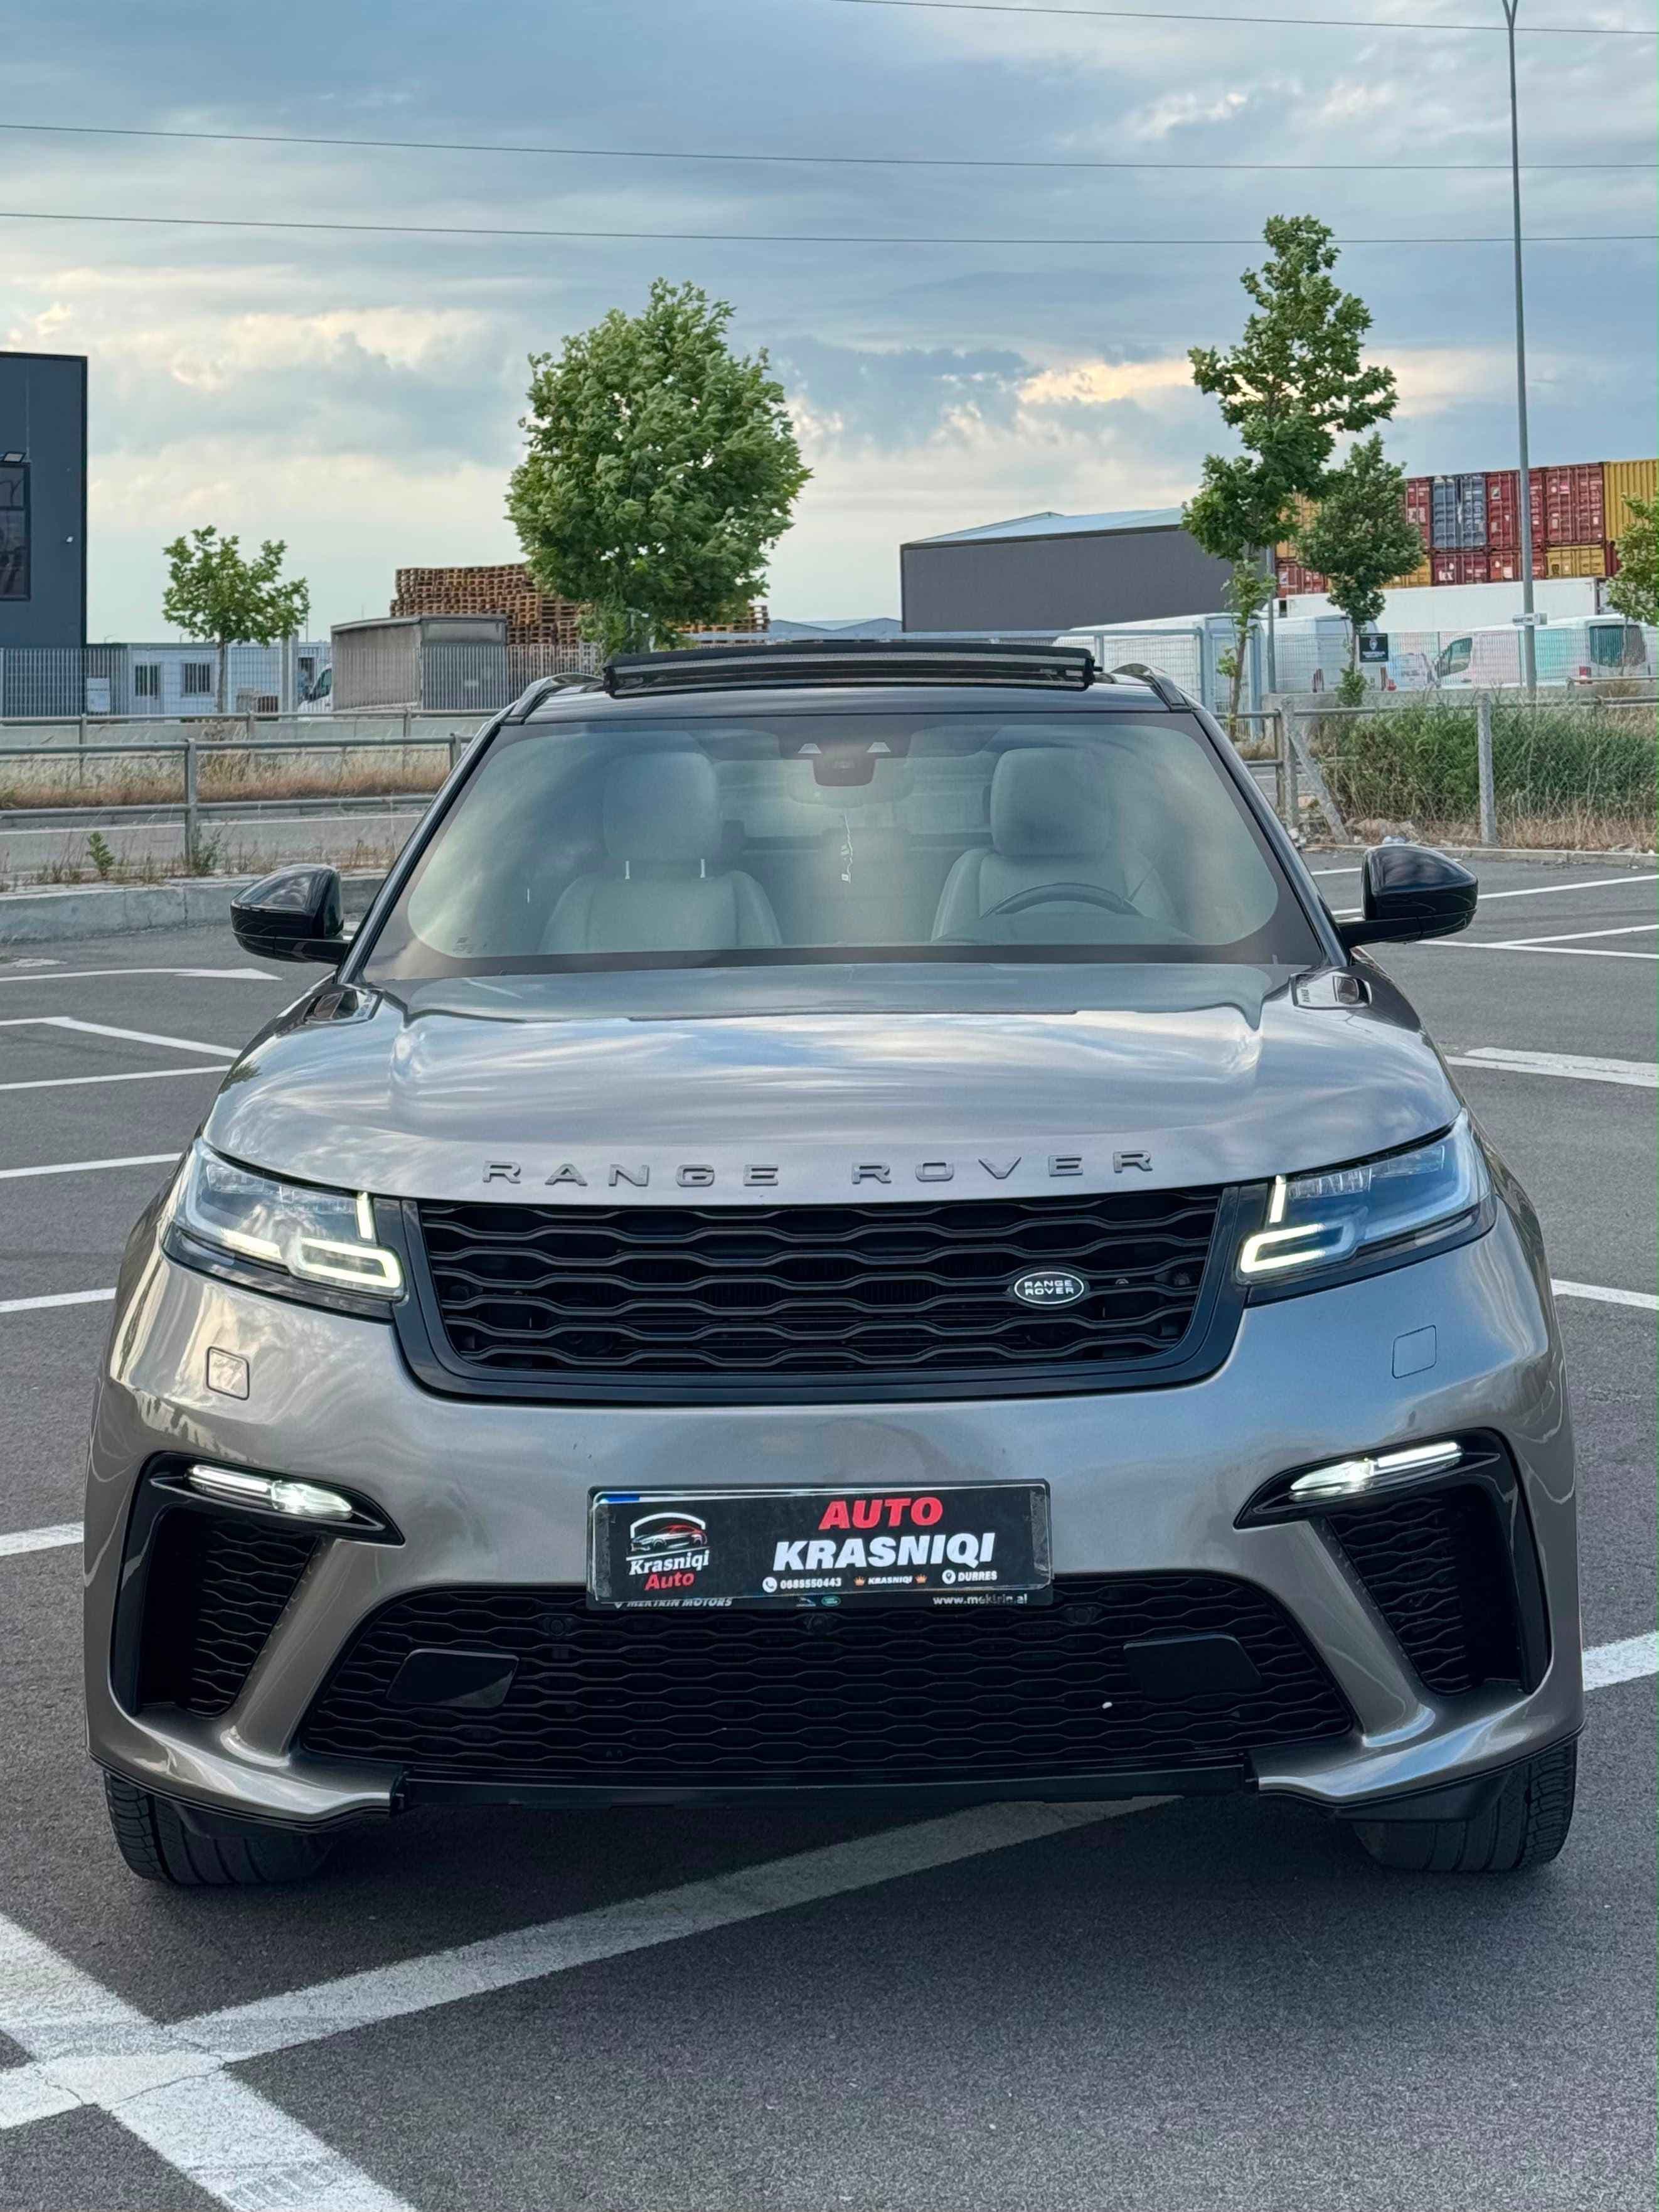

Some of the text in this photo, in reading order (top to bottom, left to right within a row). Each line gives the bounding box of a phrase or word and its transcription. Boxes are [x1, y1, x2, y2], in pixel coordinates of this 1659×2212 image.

[483, 1150, 1154, 1187] RANGE ROVER
[1024, 1280, 1072, 1288] RANGE
[1025, 1287, 1074, 1296] ROVER
[818, 1496, 943, 1531] AUTO
[772, 1532, 995, 1571] KRASNIQI
[628, 1549, 710, 1576] Krasniqi
[643, 1571, 695, 1591] Auto
[868, 1575, 913, 1585] KRASNIQI
[958, 1570, 998, 1582] DURRES
[681, 1598, 733, 1607] MOTORS
